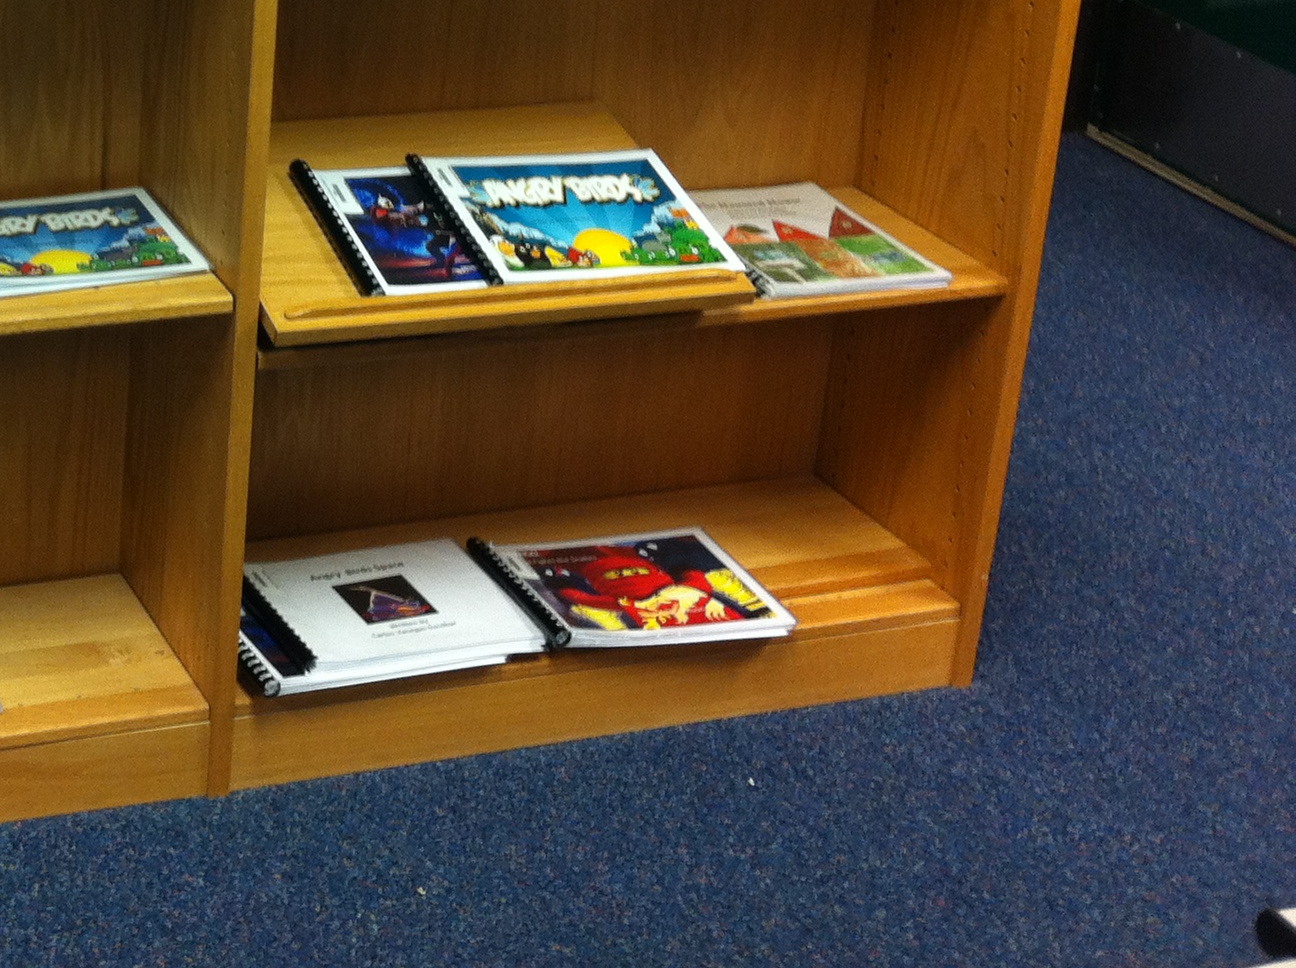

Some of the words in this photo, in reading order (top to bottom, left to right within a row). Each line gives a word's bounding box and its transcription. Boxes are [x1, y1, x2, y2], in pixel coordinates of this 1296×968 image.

[483, 176, 566, 206] ANGRY
[565, 173, 641, 203] BIRDS
[42, 207, 122, 231] BIRDS
